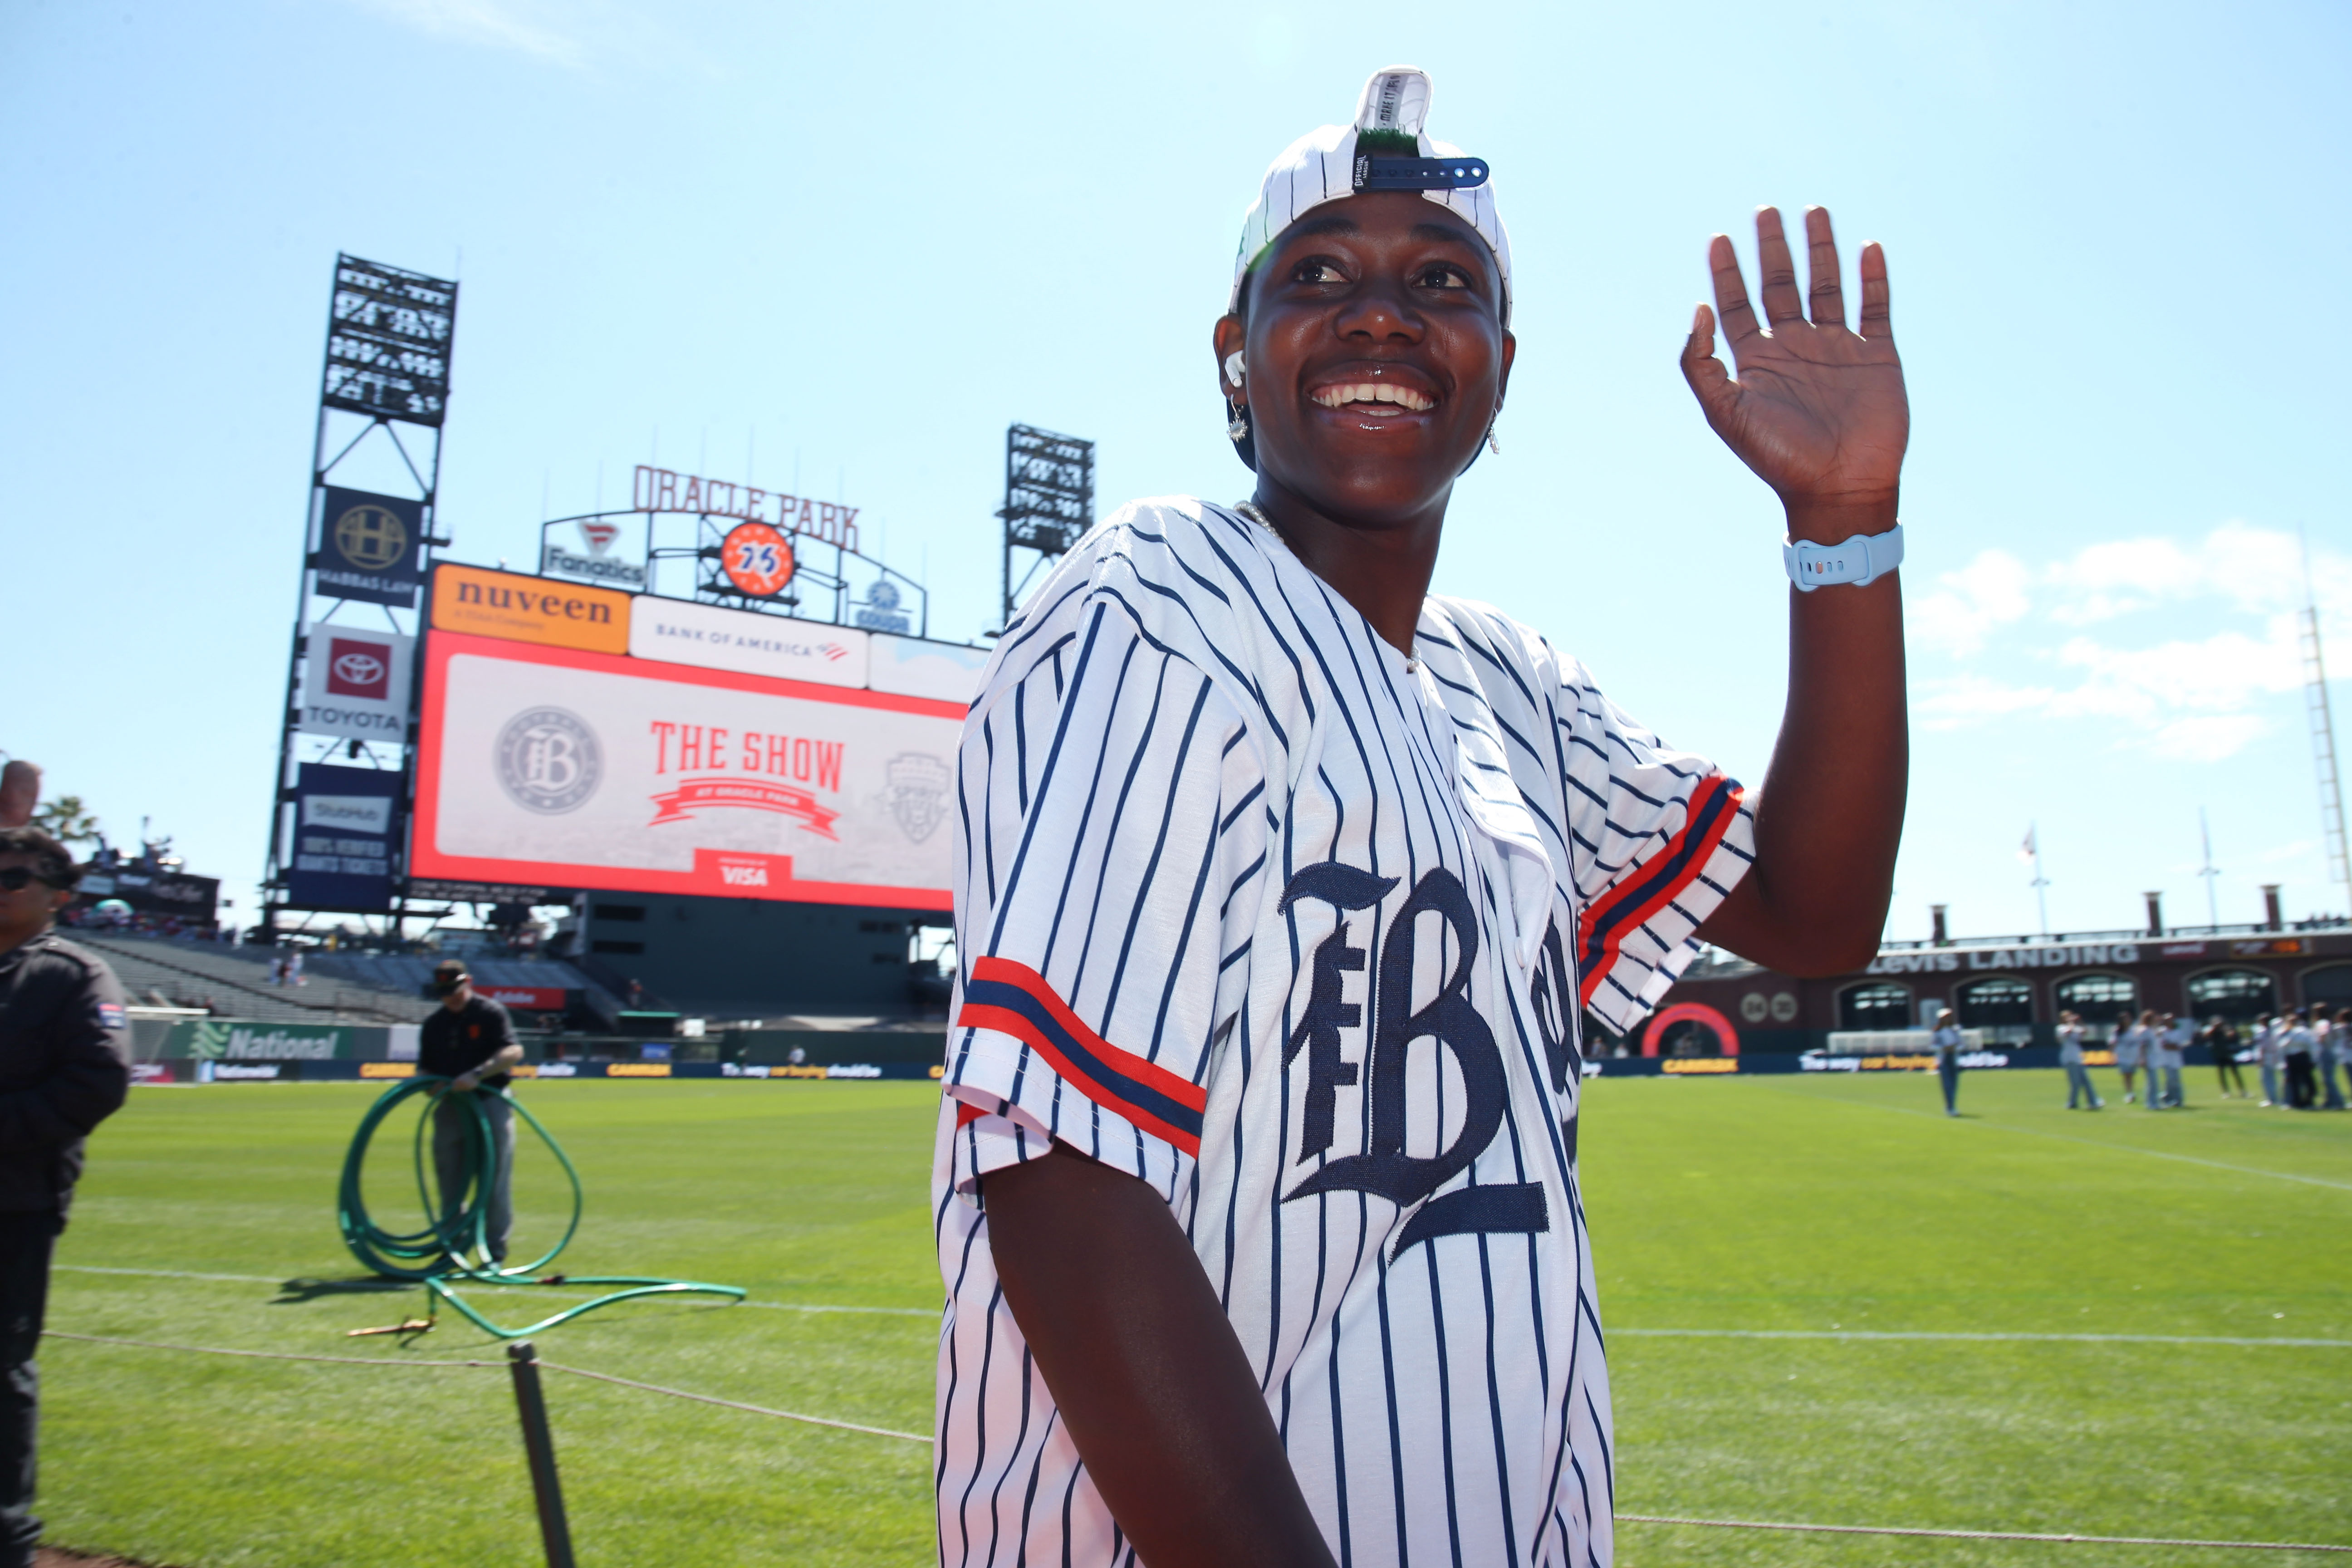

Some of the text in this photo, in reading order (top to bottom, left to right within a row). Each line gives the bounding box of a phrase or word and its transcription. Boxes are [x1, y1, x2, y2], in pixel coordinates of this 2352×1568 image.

[1354, 155, 1367, 186] OFFICIAL
[635, 465, 860, 554] ORACLE PARK
[549, 548, 643, 582] Fanatics
[457, 580, 612, 624] nuveen
[656, 623, 812, 657] BANK OF AMERICA
[309, 706, 401, 731] TOYOTA
[650, 720, 728, 775] THE
[742, 731, 844, 793] SHOW
[719, 865, 768, 887] VISA
[1968, 944, 2140, 970] LANDING
[225, 1028, 339, 1060] National
